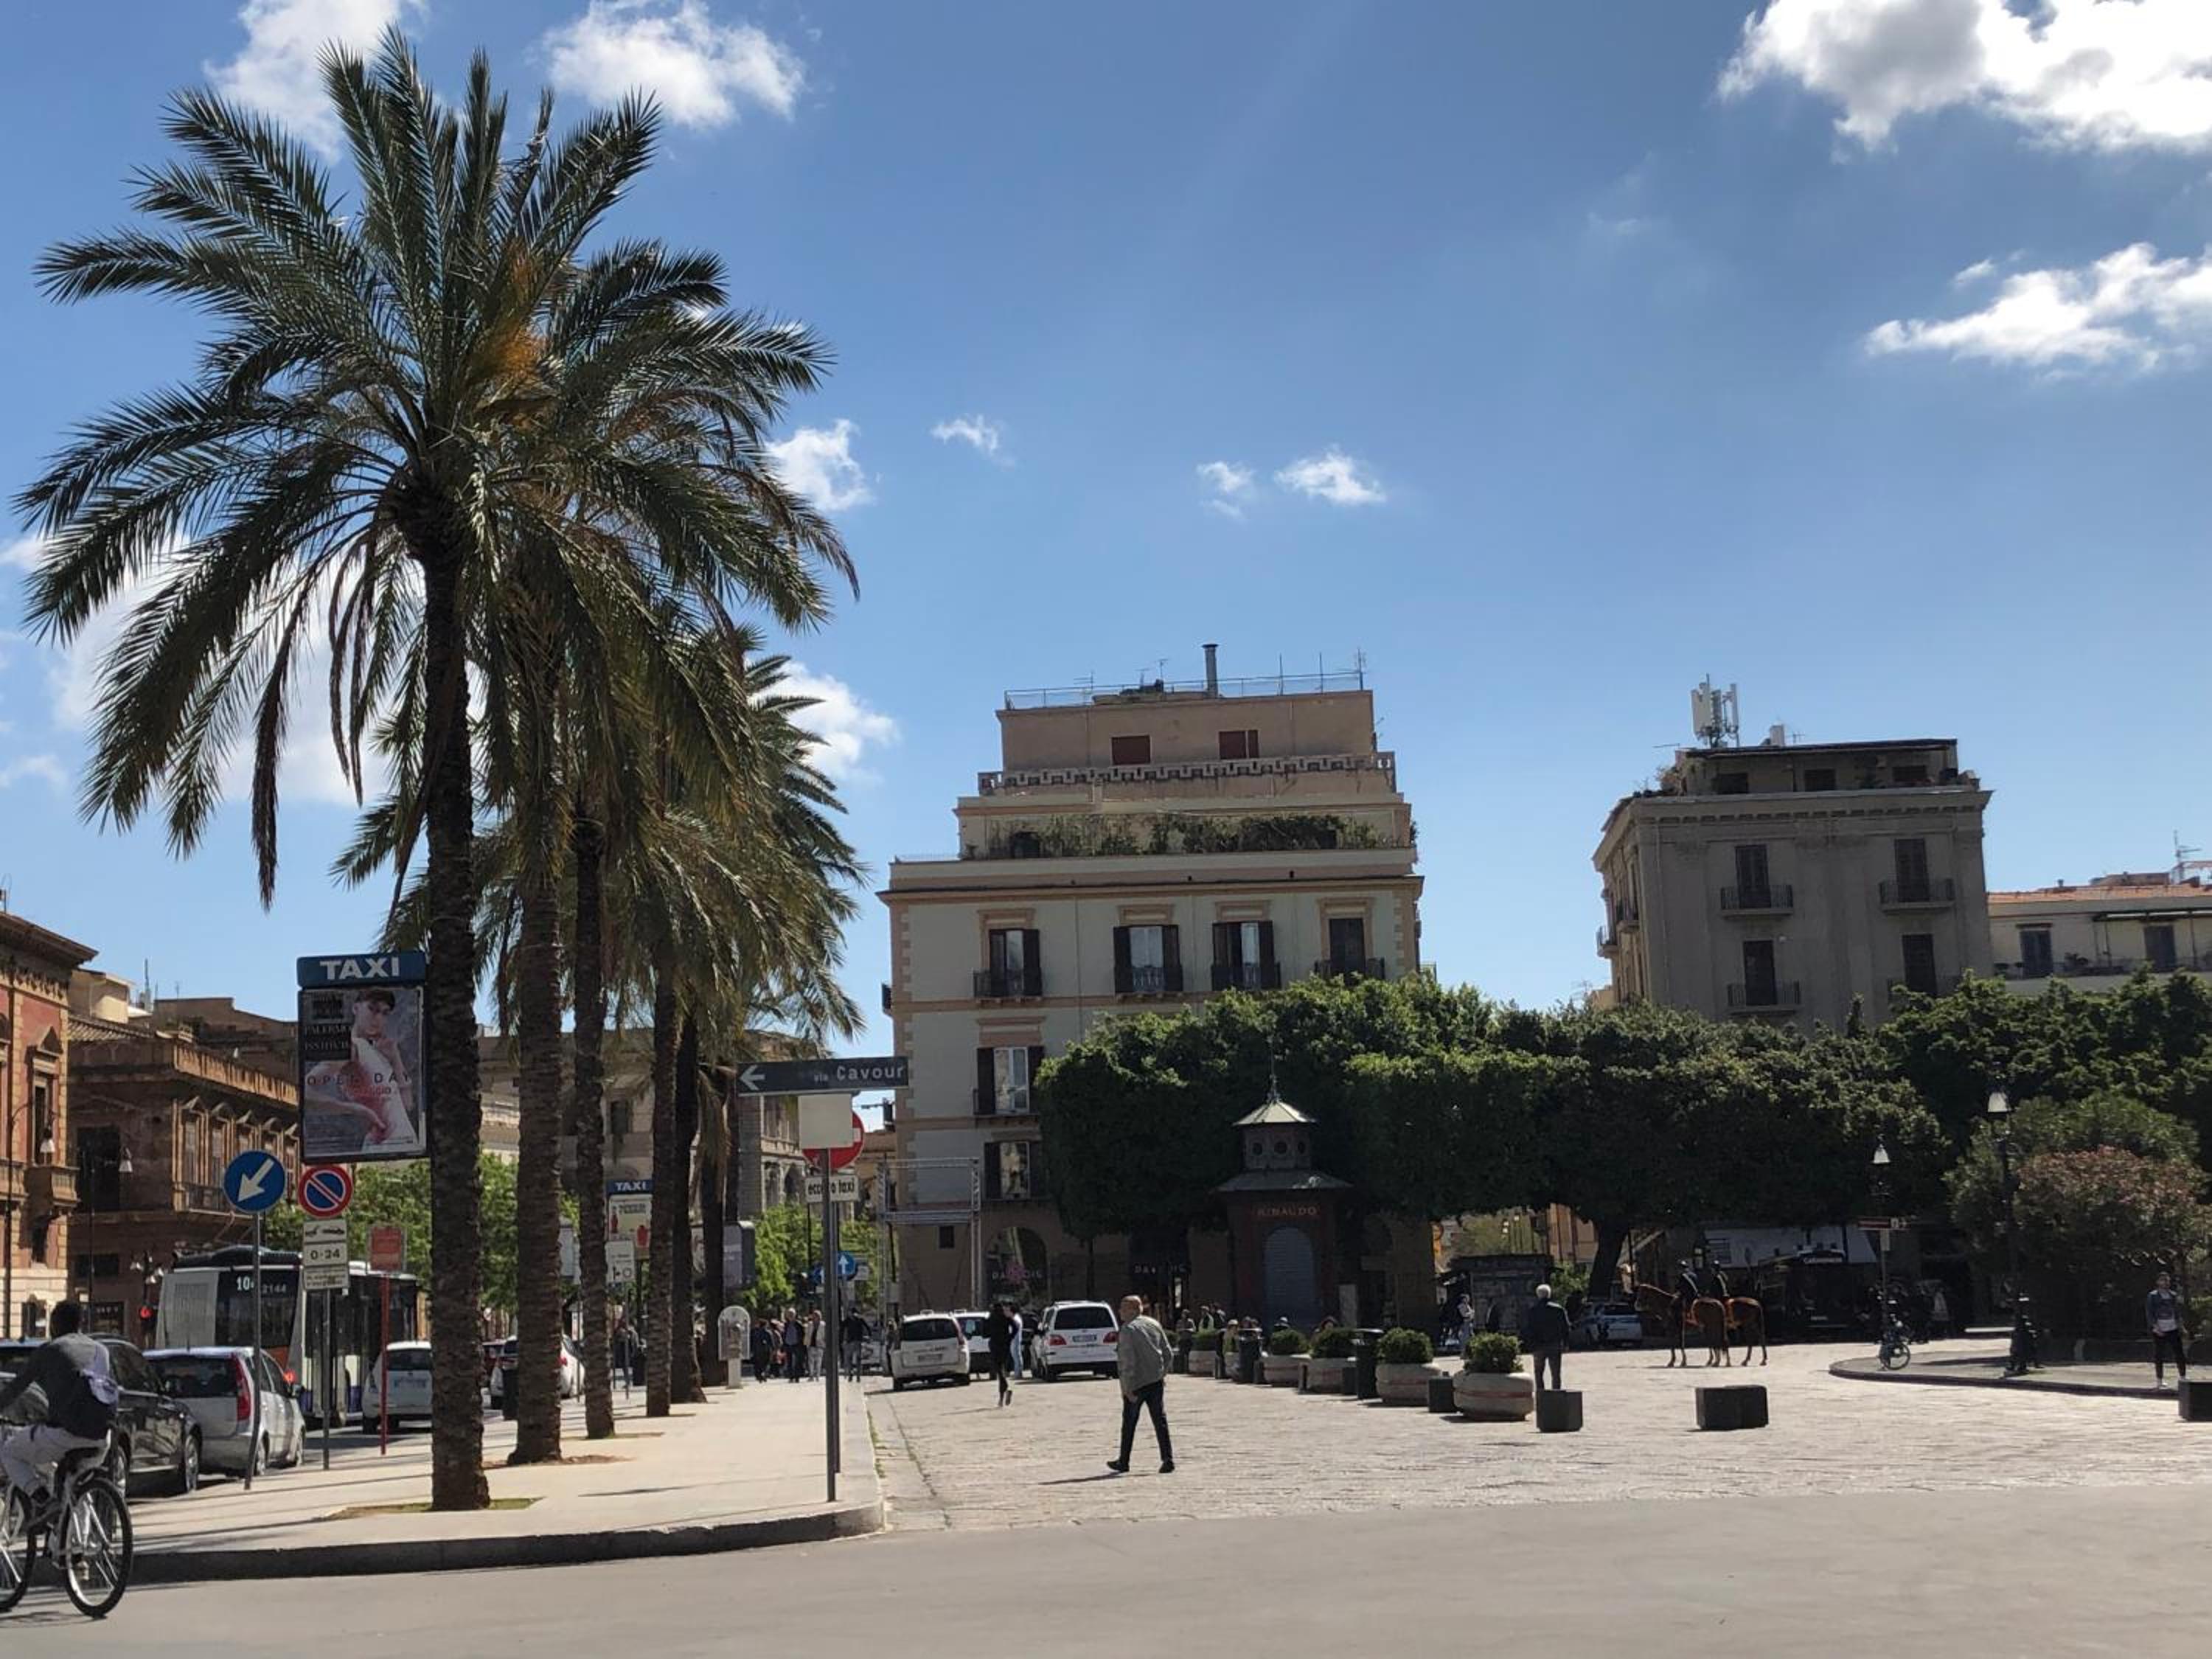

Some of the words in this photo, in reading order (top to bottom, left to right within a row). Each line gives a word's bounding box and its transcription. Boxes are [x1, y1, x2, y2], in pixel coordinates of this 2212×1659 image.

[320, 957, 400, 980] TAXI
[374, 1072, 411, 1083] DAY
[837, 1065, 904, 1080] Cavour
[615, 1181, 647, 1192] TAXI
[838, 1178, 855, 1194] taxi
